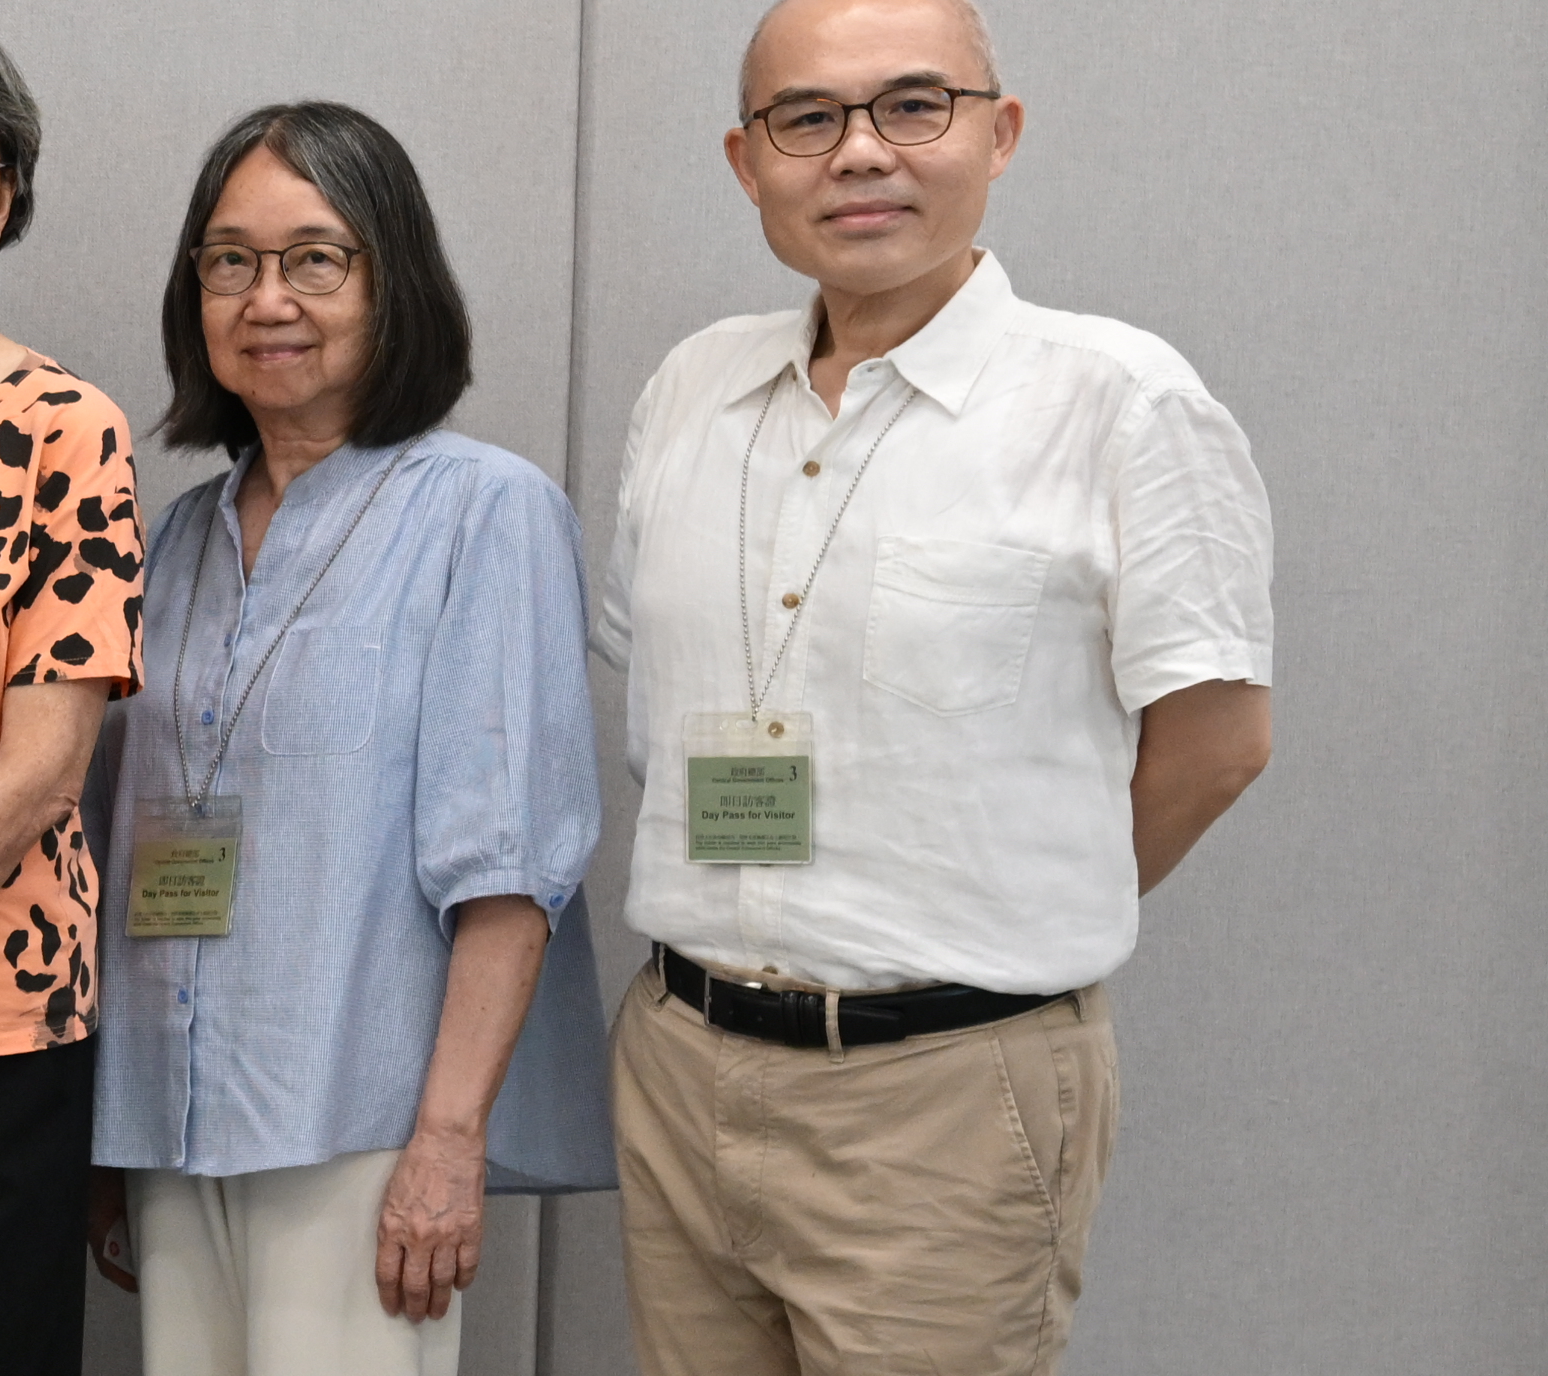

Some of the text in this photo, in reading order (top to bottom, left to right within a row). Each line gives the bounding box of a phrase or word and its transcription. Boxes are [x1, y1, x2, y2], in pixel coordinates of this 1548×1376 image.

[789, 765, 797, 781] 3
[702, 810, 795, 821] Day Pass for Visitor
[219, 847, 226, 862] 3
[142, 890, 157, 898] Day
[194, 888, 219, 897] Visitor
